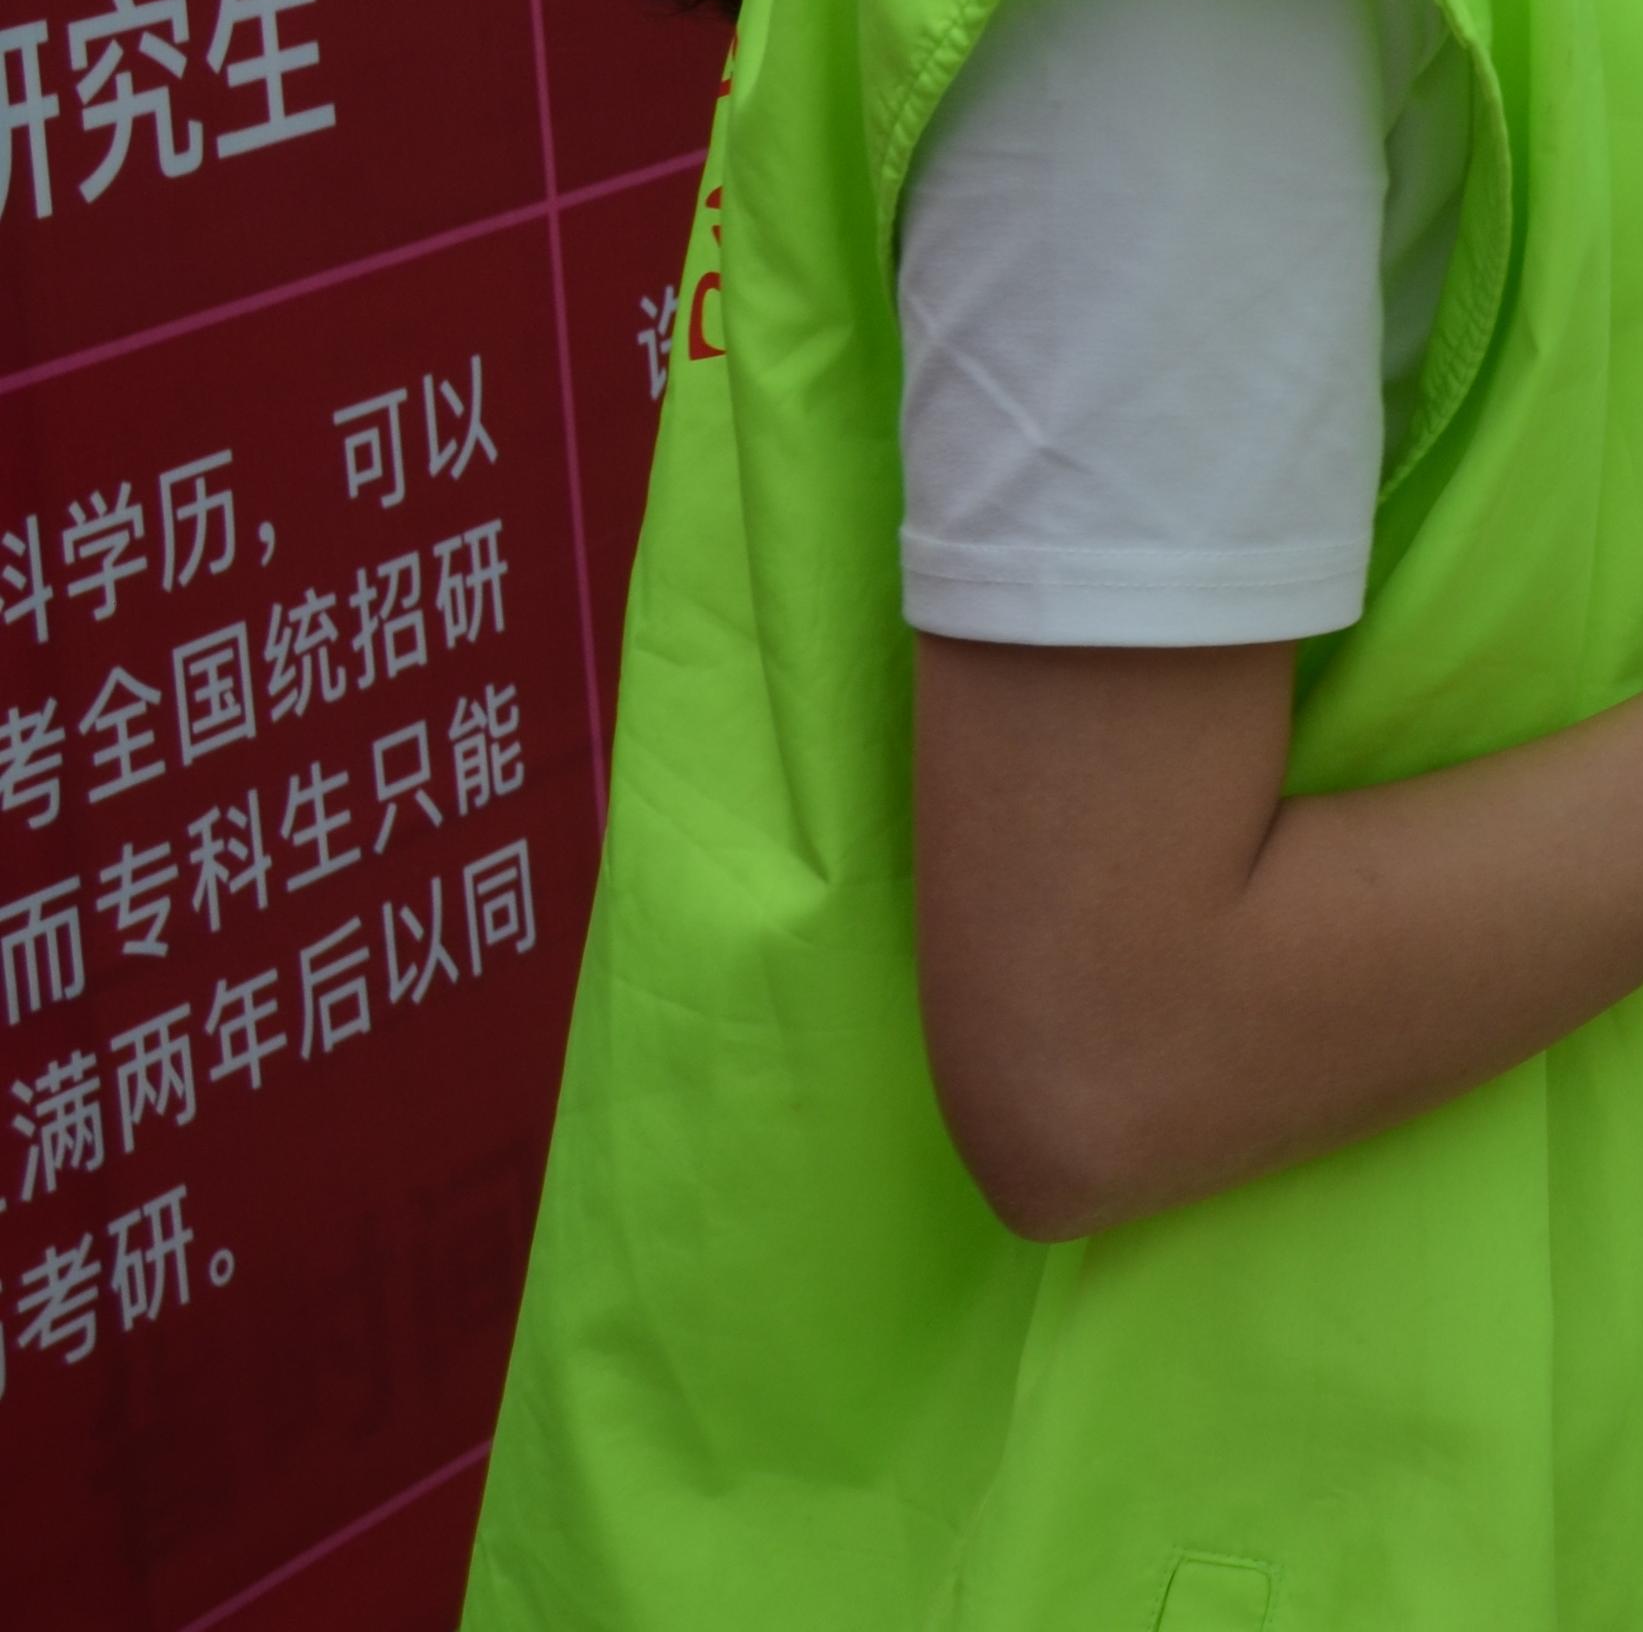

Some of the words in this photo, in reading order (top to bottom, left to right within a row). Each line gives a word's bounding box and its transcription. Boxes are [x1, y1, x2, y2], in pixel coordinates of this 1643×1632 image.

[0, 684, 525, 1026] 而专科生只能
[0, 838, 538, 1212] 满两年后以同
[0, 1184, 235, 1388] 考研。
